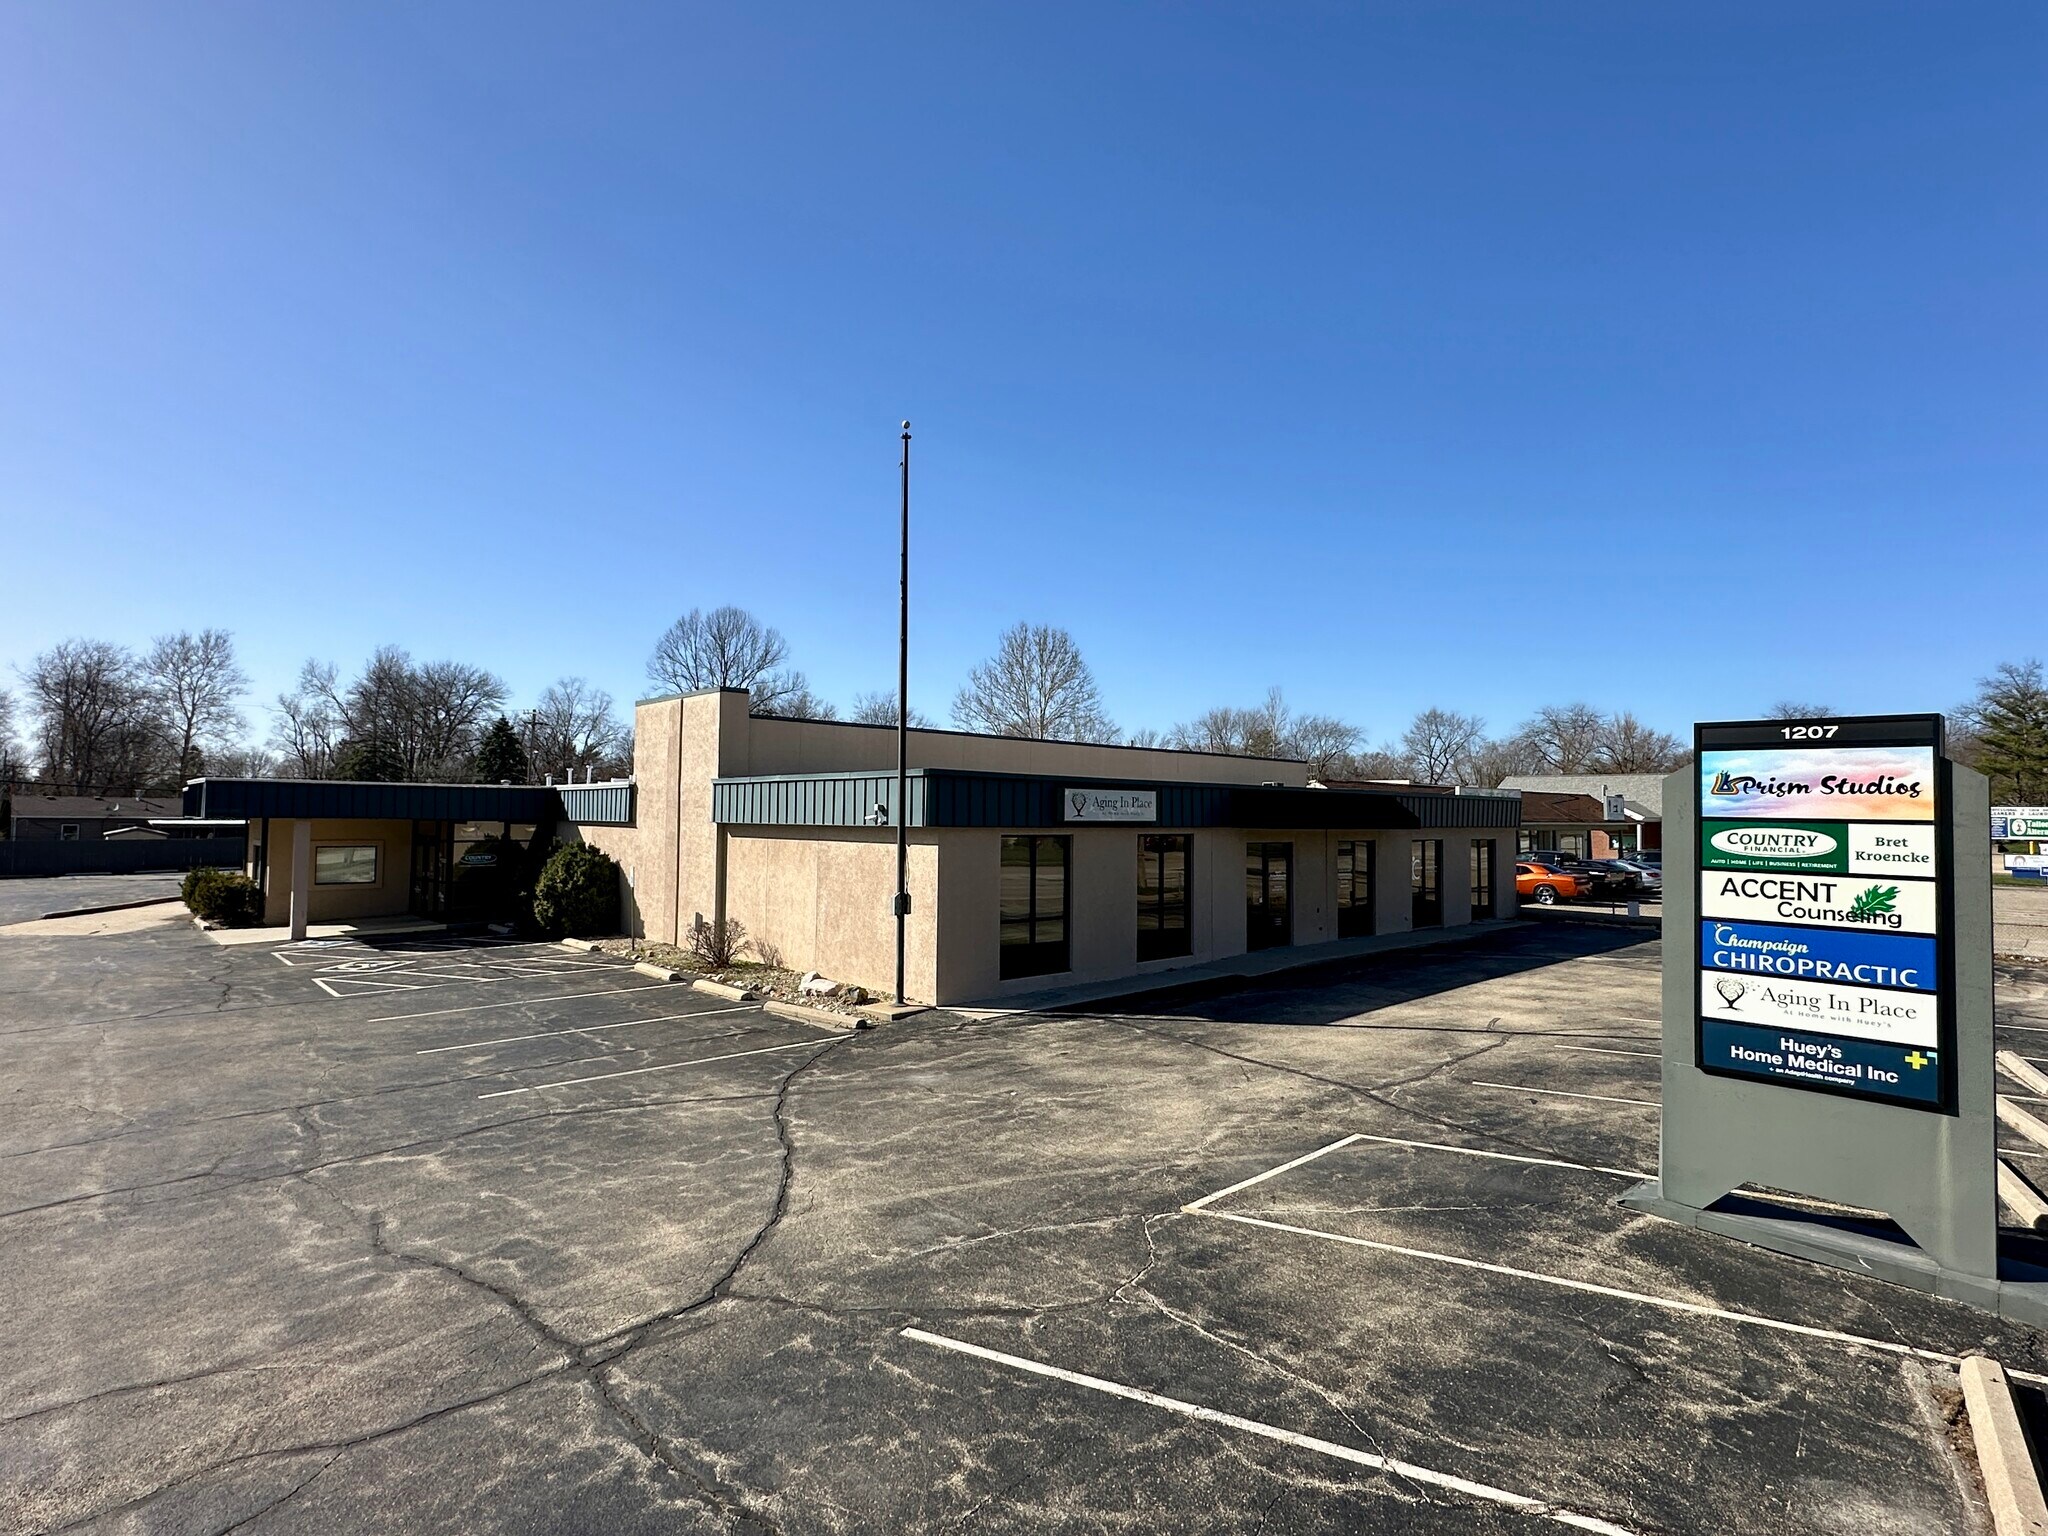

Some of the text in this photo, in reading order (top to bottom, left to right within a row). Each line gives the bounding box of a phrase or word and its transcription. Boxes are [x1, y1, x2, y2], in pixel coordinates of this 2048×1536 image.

[1781, 725, 1839, 740] 1207
[1742, 775, 1923, 798] Prism Studios
[1092, 796, 1153, 811] Aging In Place
[1727, 832, 1819, 847] COUNTRY
[1875, 836, 1909, 848] Bret
[1744, 846, 1801, 854] FINANCIAL
[1855, 851, 1930, 863] Kroencke
[1720, 877, 1837, 903] ACCENT
[1777, 901, 1902, 928] Counseling
[1714, 923, 1809, 955] Champaign
[1713, 950, 1919, 987] CHIROPRACTIC
[1761, 987, 1917, 1020] Aging In Place
[1798, 1011, 1825, 1019] Home
[1830, 1014, 1851, 1022] with
[1857, 1018, 1892, 1028] Huey's
[1780, 1037, 1842, 1059] Huey's
[1730, 1045, 1899, 1083] Home Medical Inc
[1824, 1075, 1855, 1086] company
